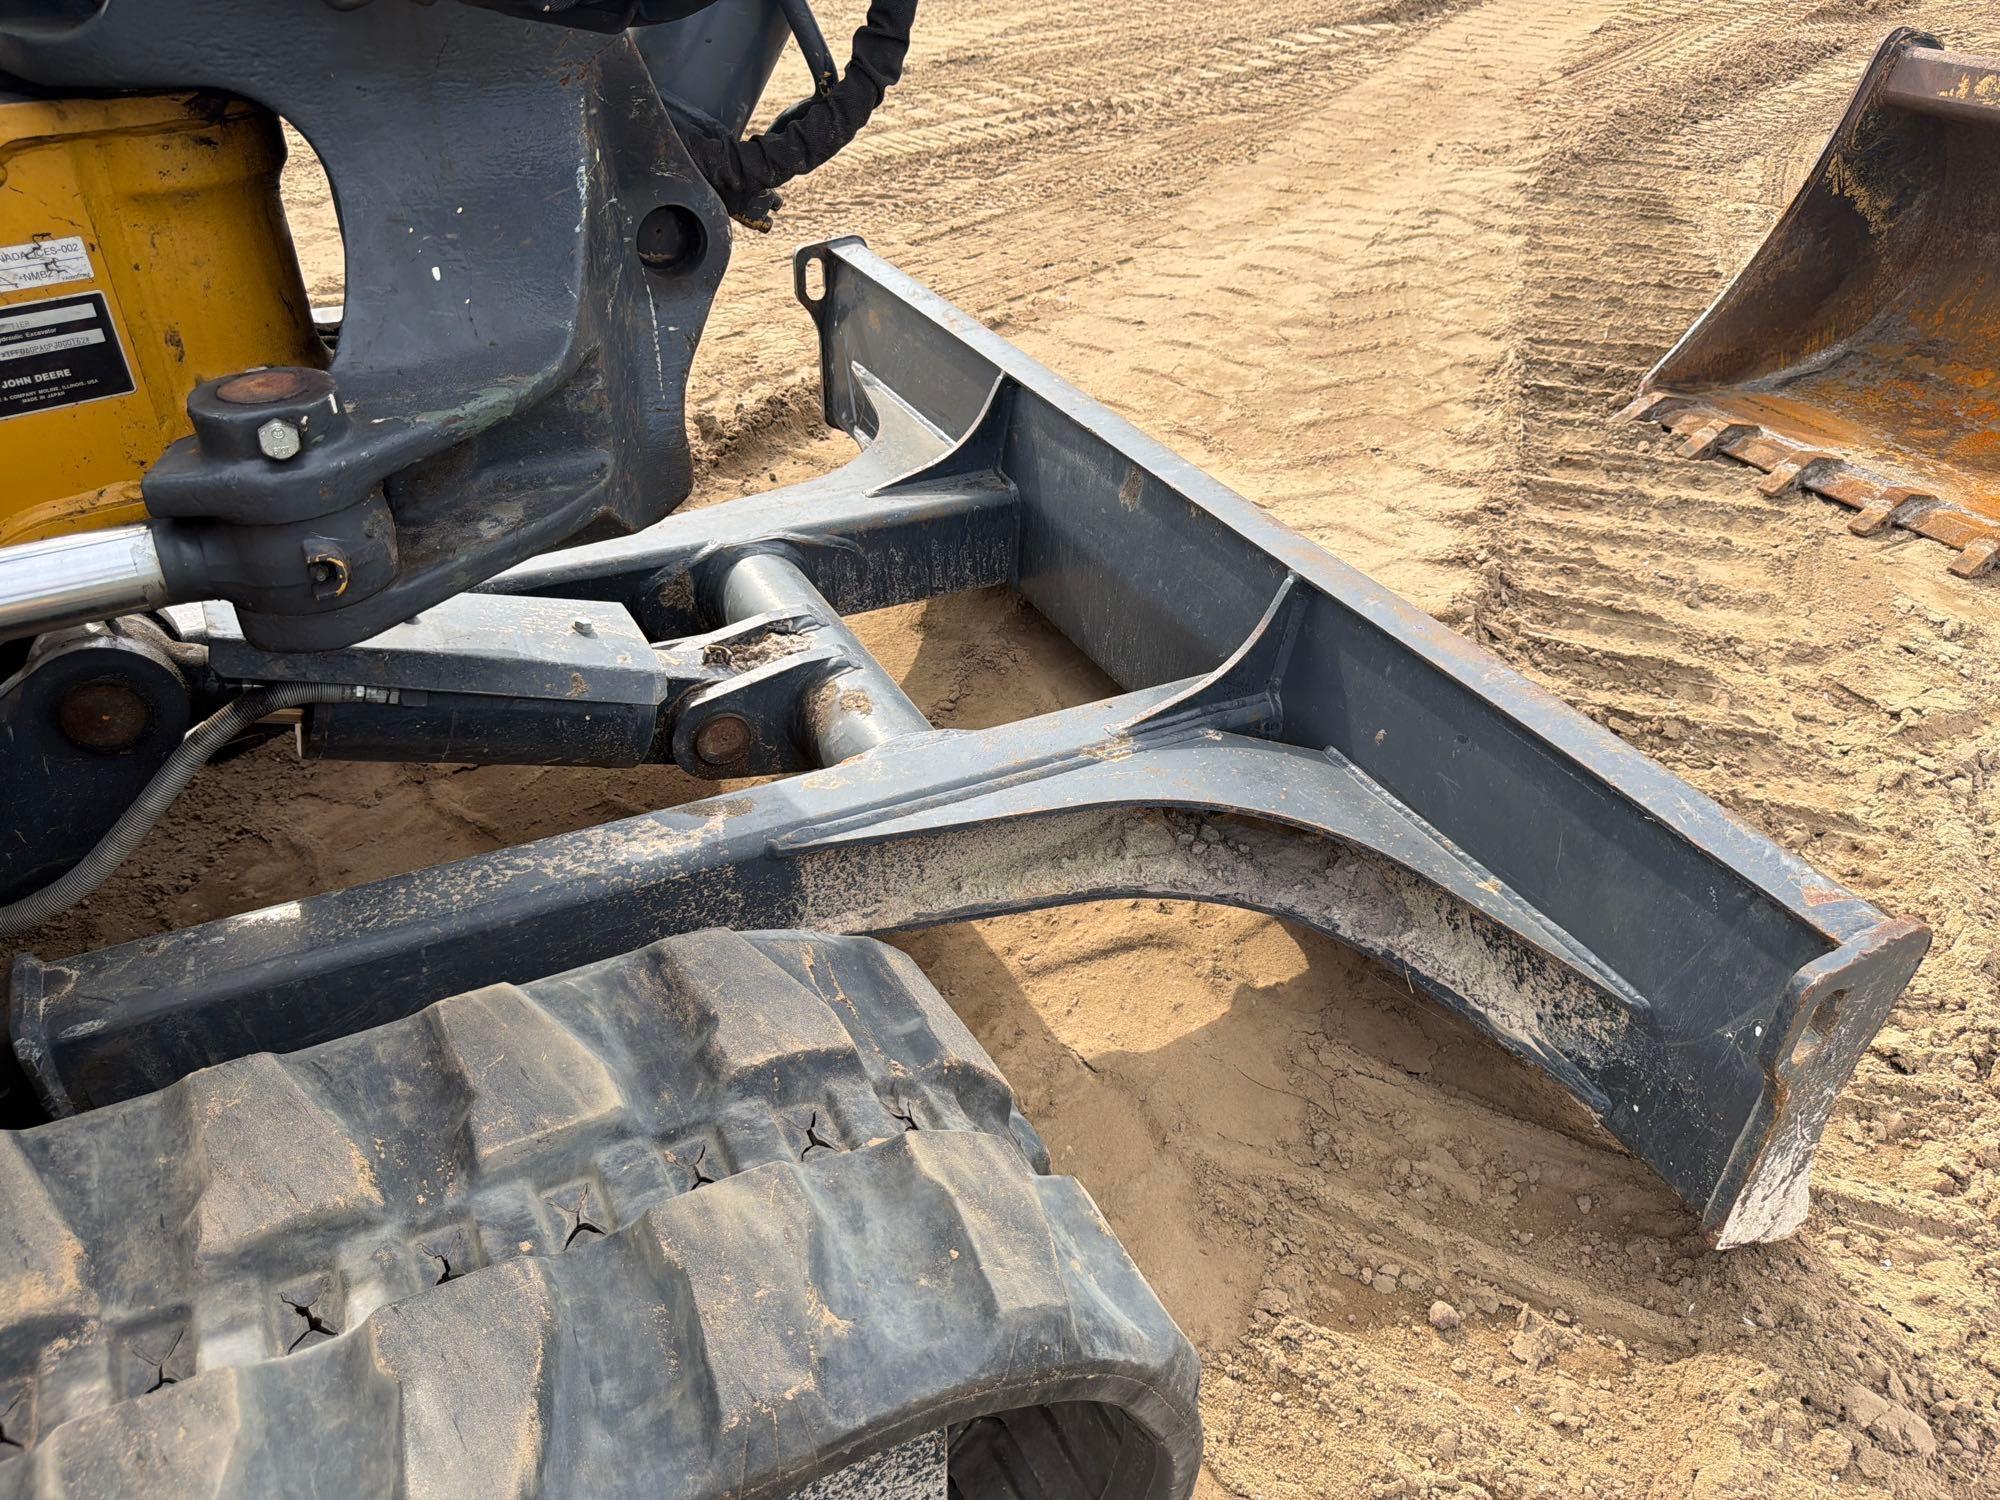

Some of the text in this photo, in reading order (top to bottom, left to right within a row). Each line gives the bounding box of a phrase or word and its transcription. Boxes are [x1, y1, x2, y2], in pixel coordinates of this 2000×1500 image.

[2, 368, 72, 389] JOHN DEERE
[9, 391, 37, 400] COMPANY
[47, 391, 65, 399] JAPAN
